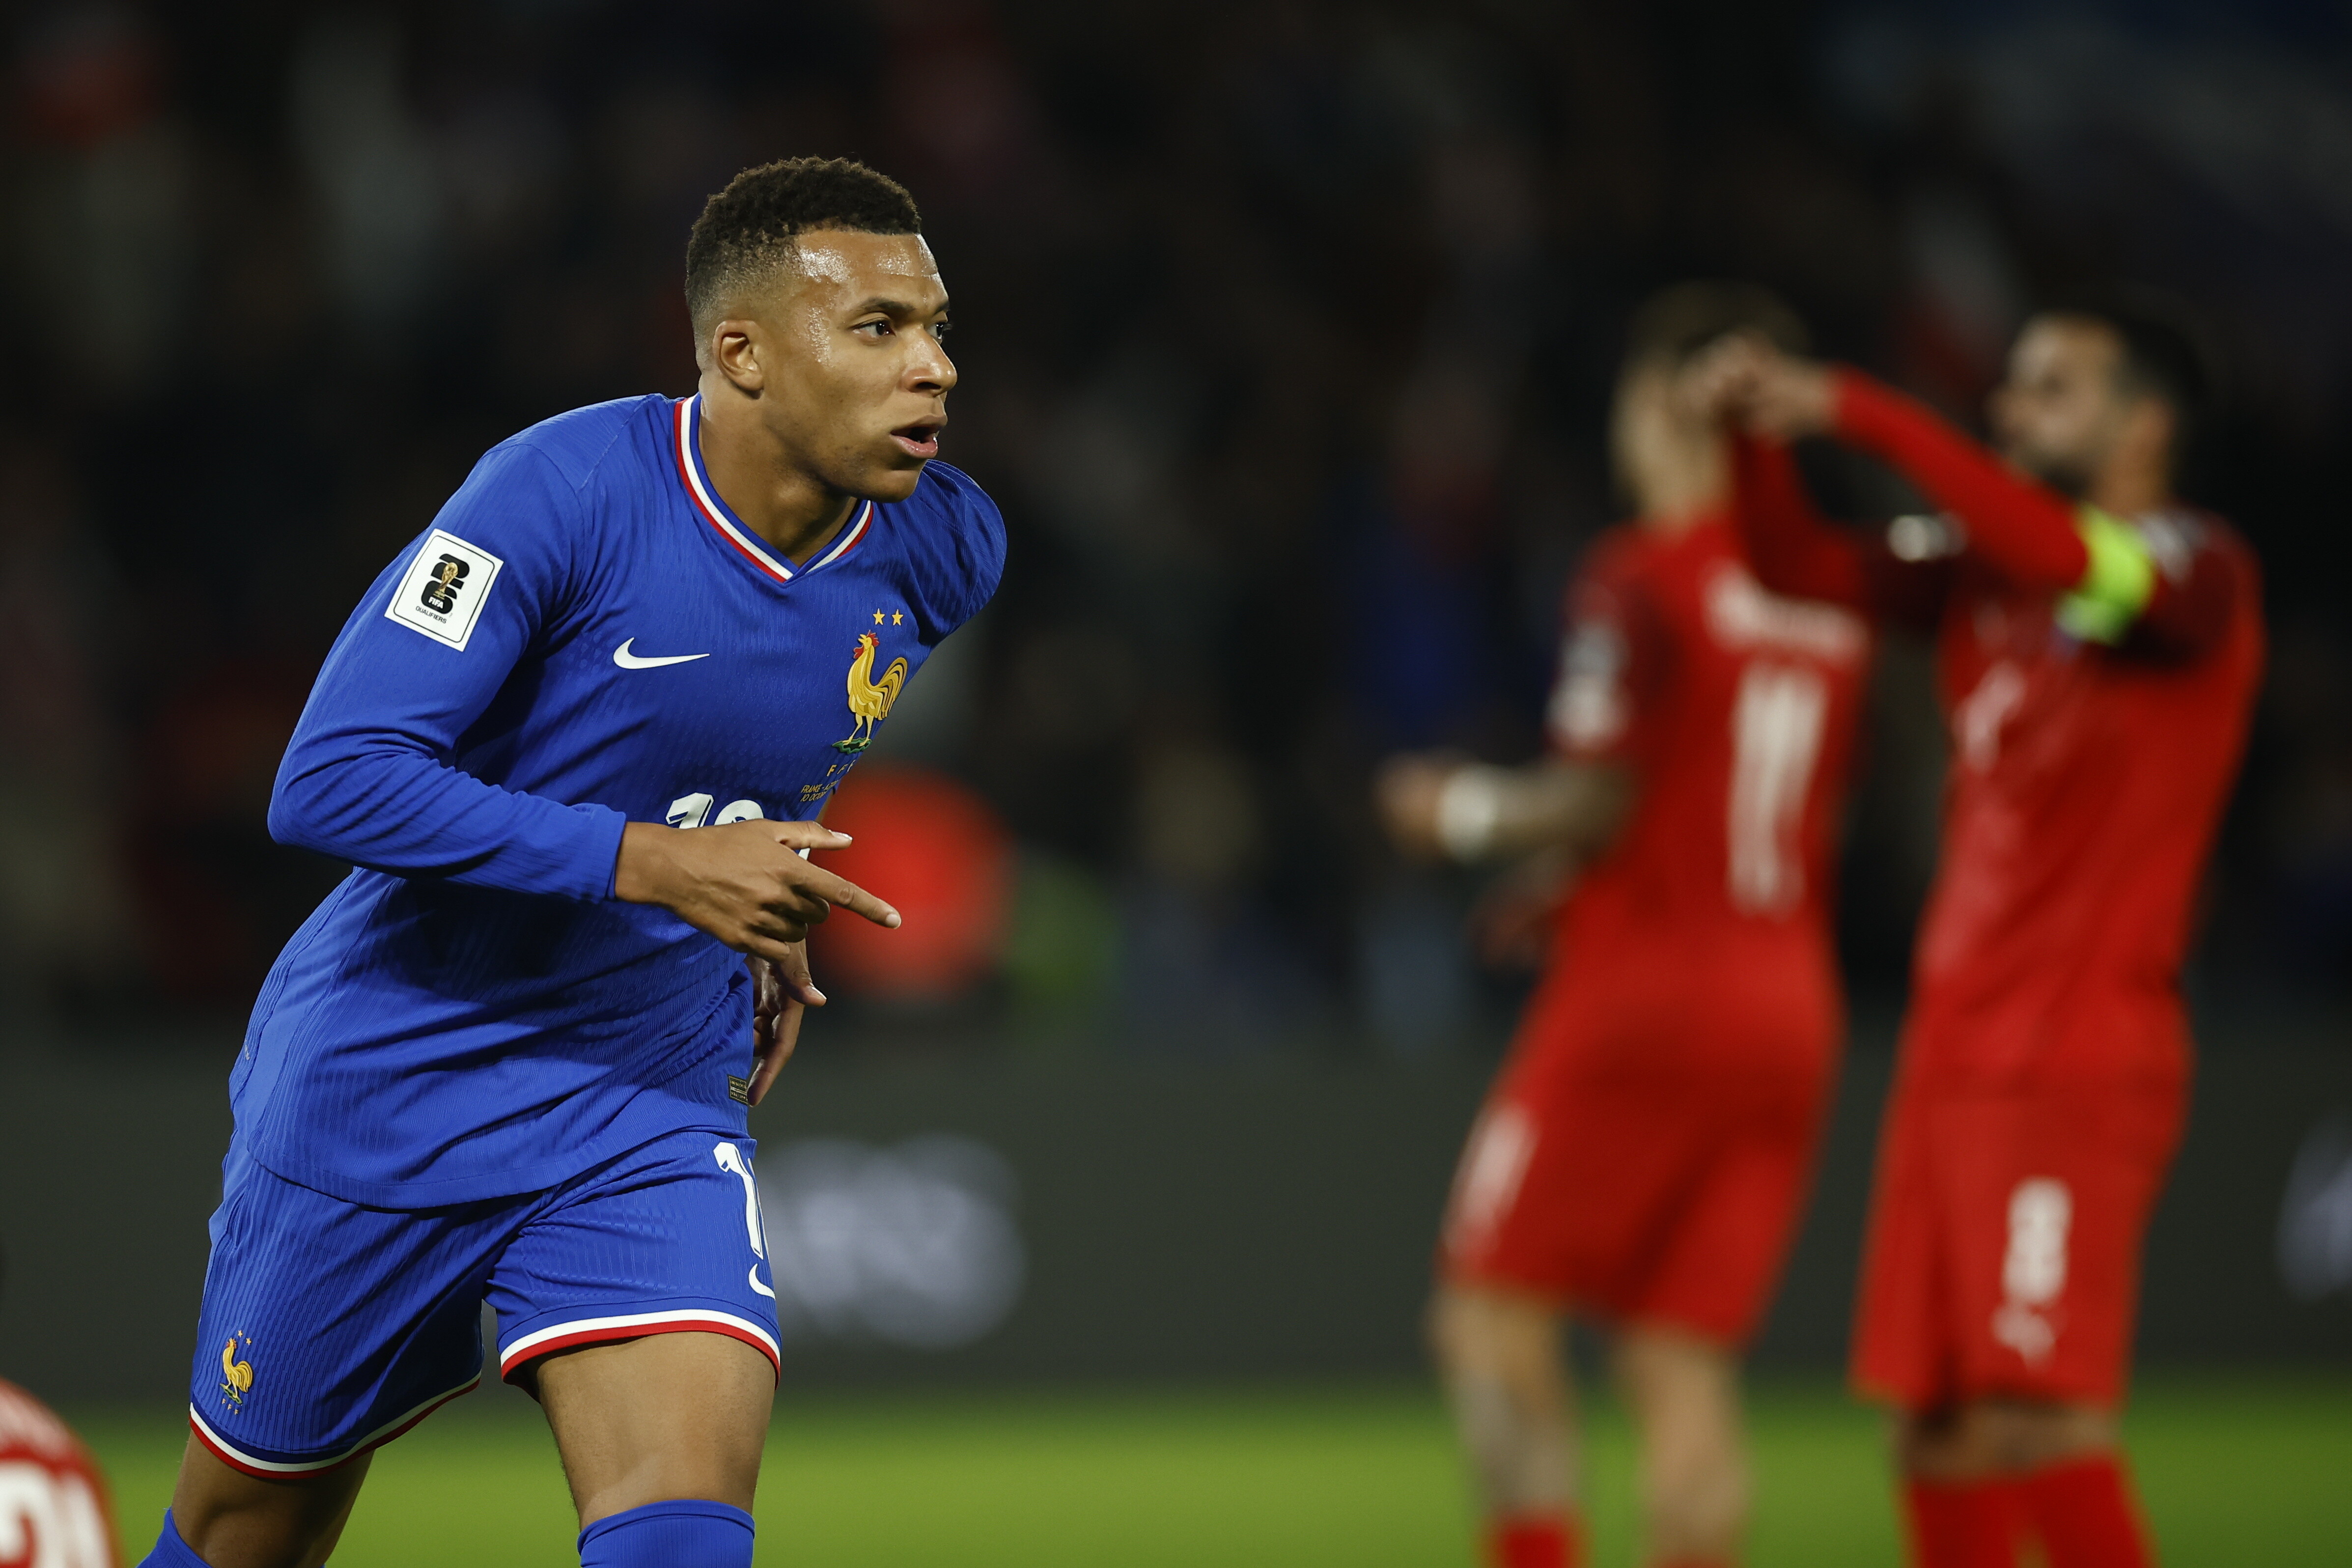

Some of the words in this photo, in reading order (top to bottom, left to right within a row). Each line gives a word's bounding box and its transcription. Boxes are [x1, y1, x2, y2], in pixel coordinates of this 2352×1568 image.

[428, 596, 444, 609] FIFA
[416, 606, 447, 624] QUALIFIERS
[800, 784, 823, 793] FRANCE
